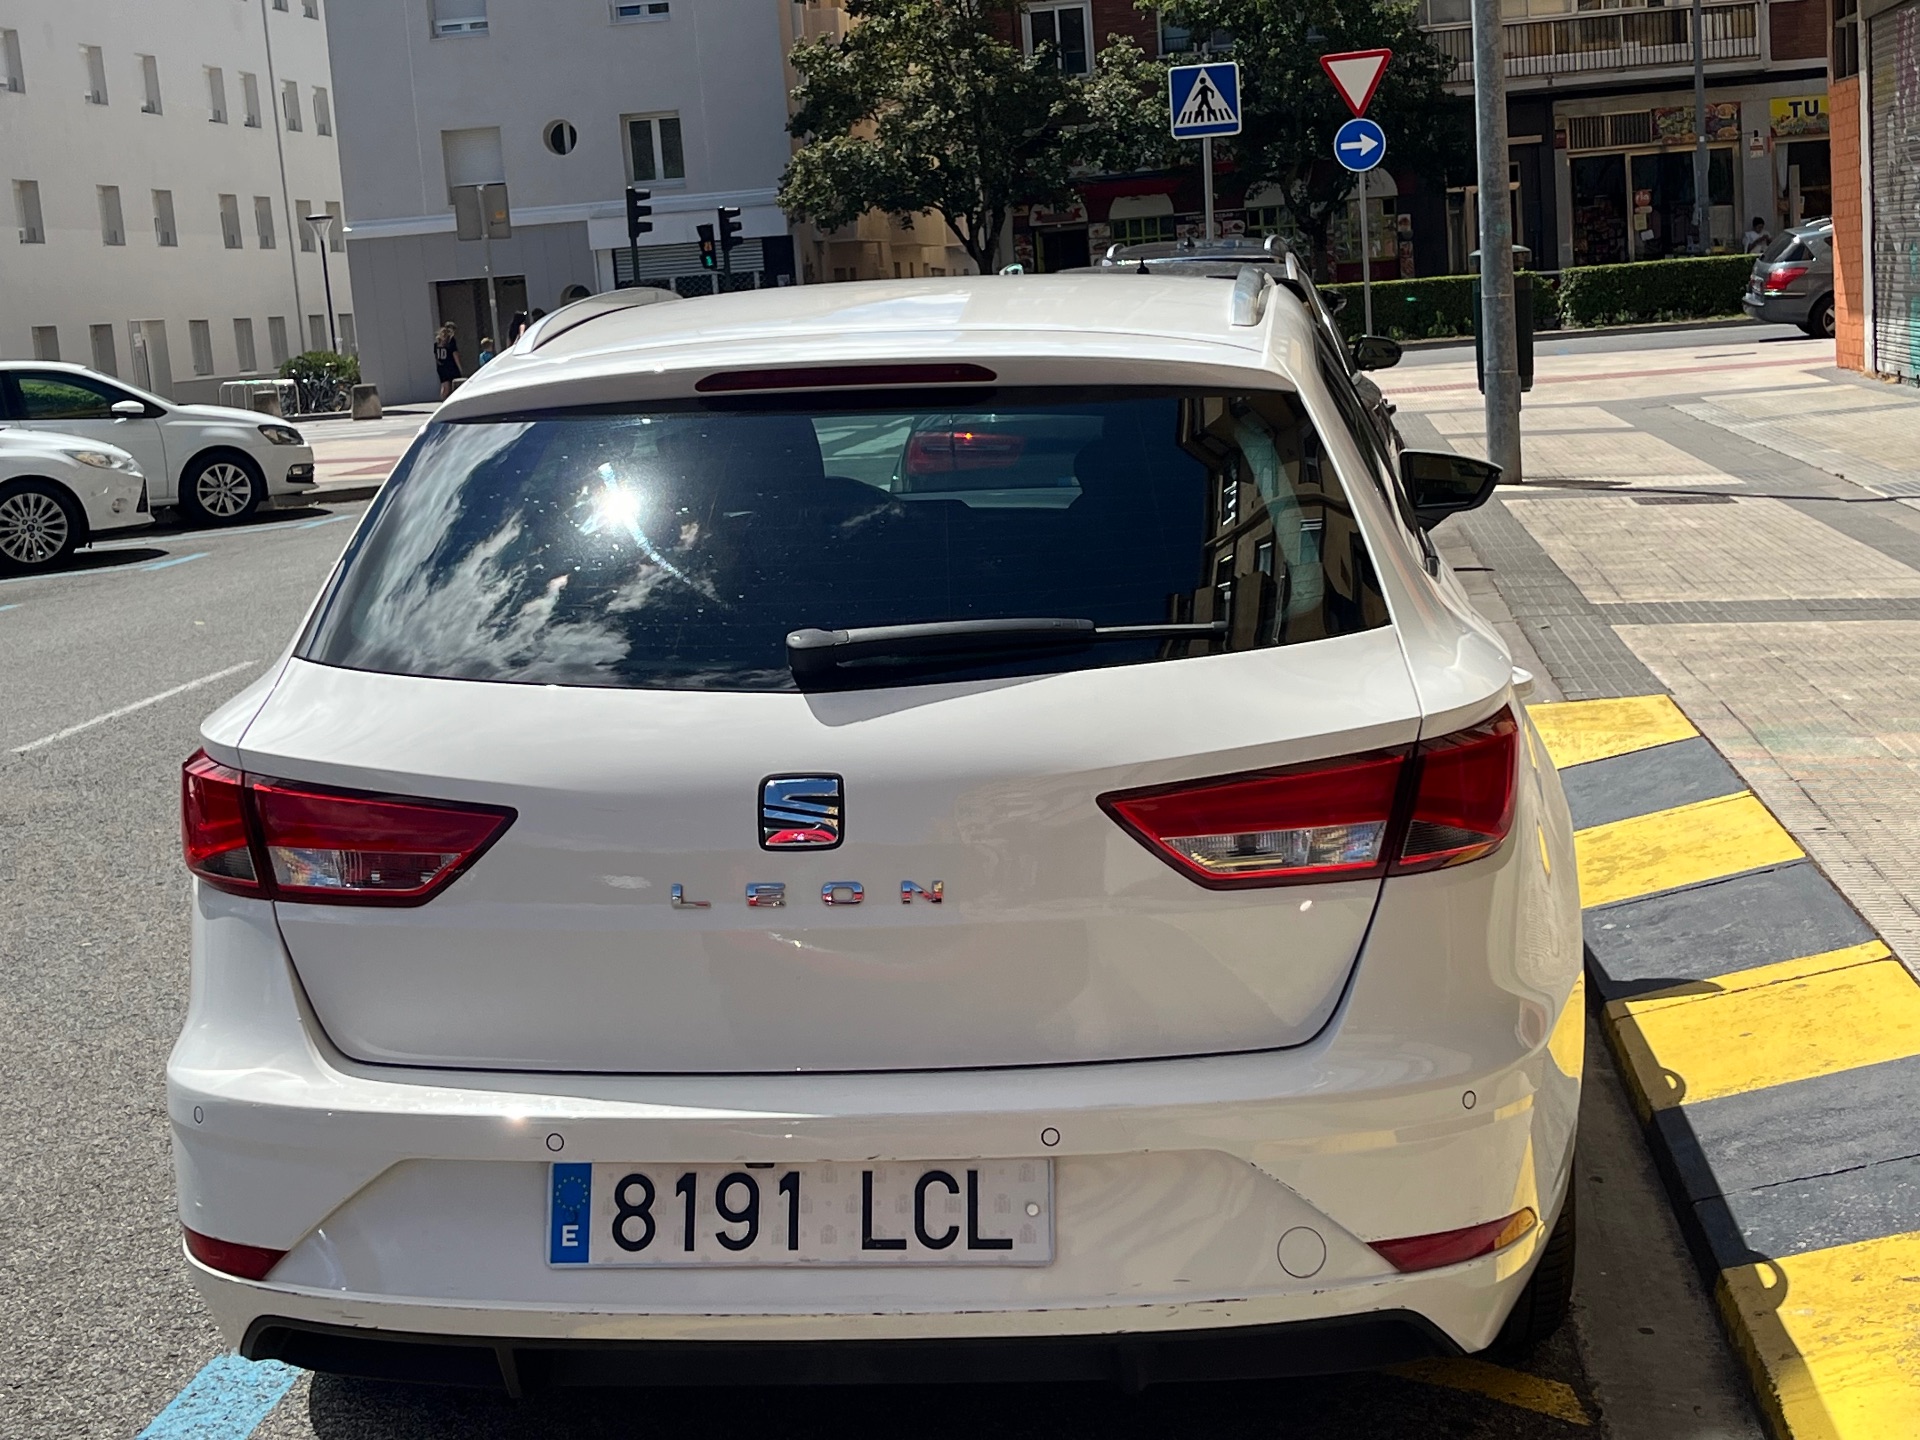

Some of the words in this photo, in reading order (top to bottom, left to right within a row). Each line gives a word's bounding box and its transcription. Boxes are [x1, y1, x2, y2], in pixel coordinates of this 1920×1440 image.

[1788, 100, 1819, 118] TU
[671, 880, 944, 909] LEON
[612, 1171, 799, 1252] 8191
[862, 1170, 1013, 1250] LCL
[562, 1225, 579, 1246] E
